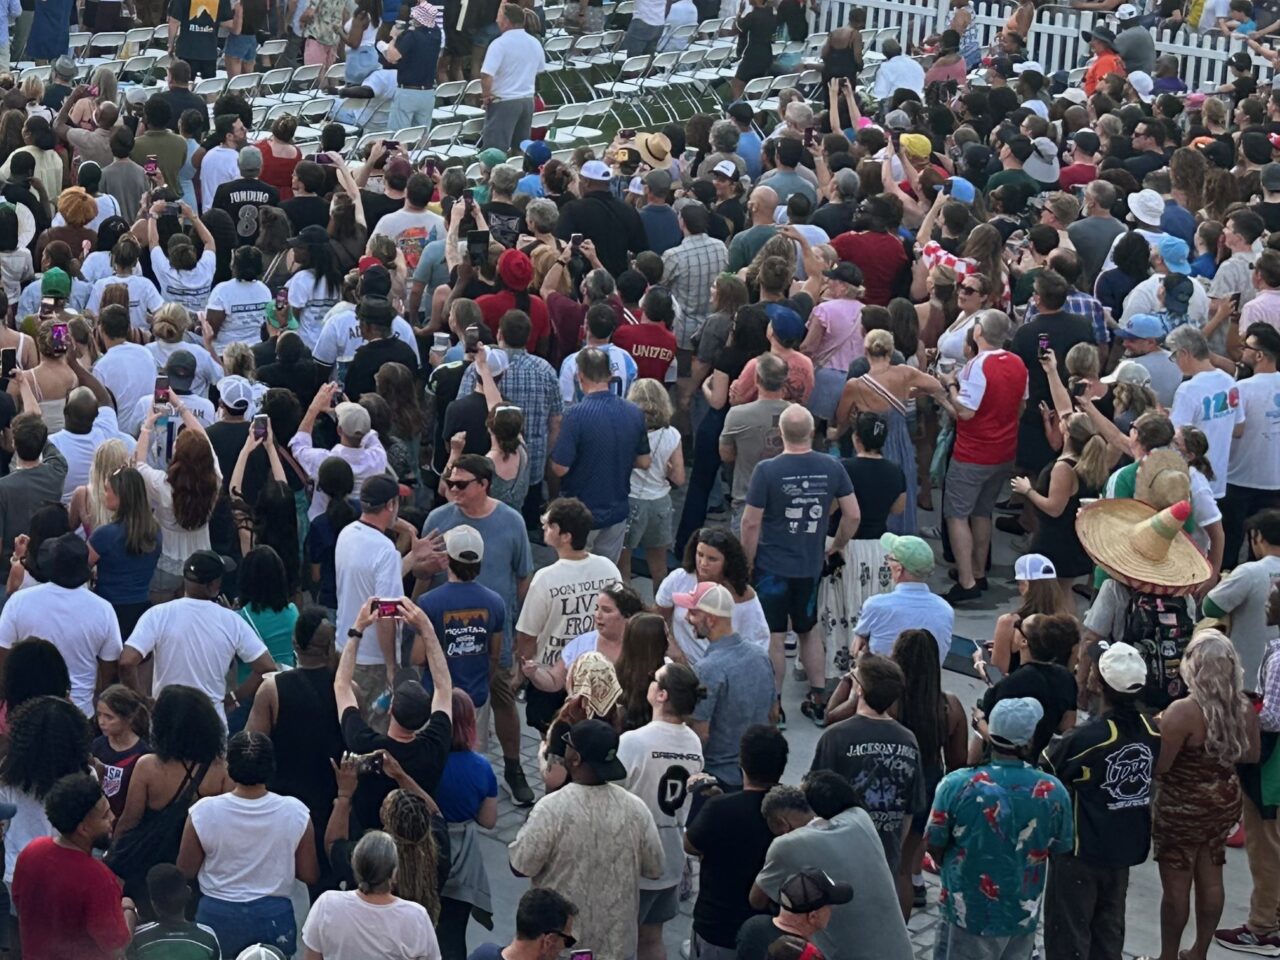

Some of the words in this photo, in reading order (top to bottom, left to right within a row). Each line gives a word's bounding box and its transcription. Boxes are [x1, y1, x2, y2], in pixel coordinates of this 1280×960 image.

[632, 344, 673, 361] UNITED
[549, 583, 576, 598] DON
[561, 594, 599, 615] LIV
[564, 615, 595, 636] FRO
[846, 743, 896, 757] JACKSON
